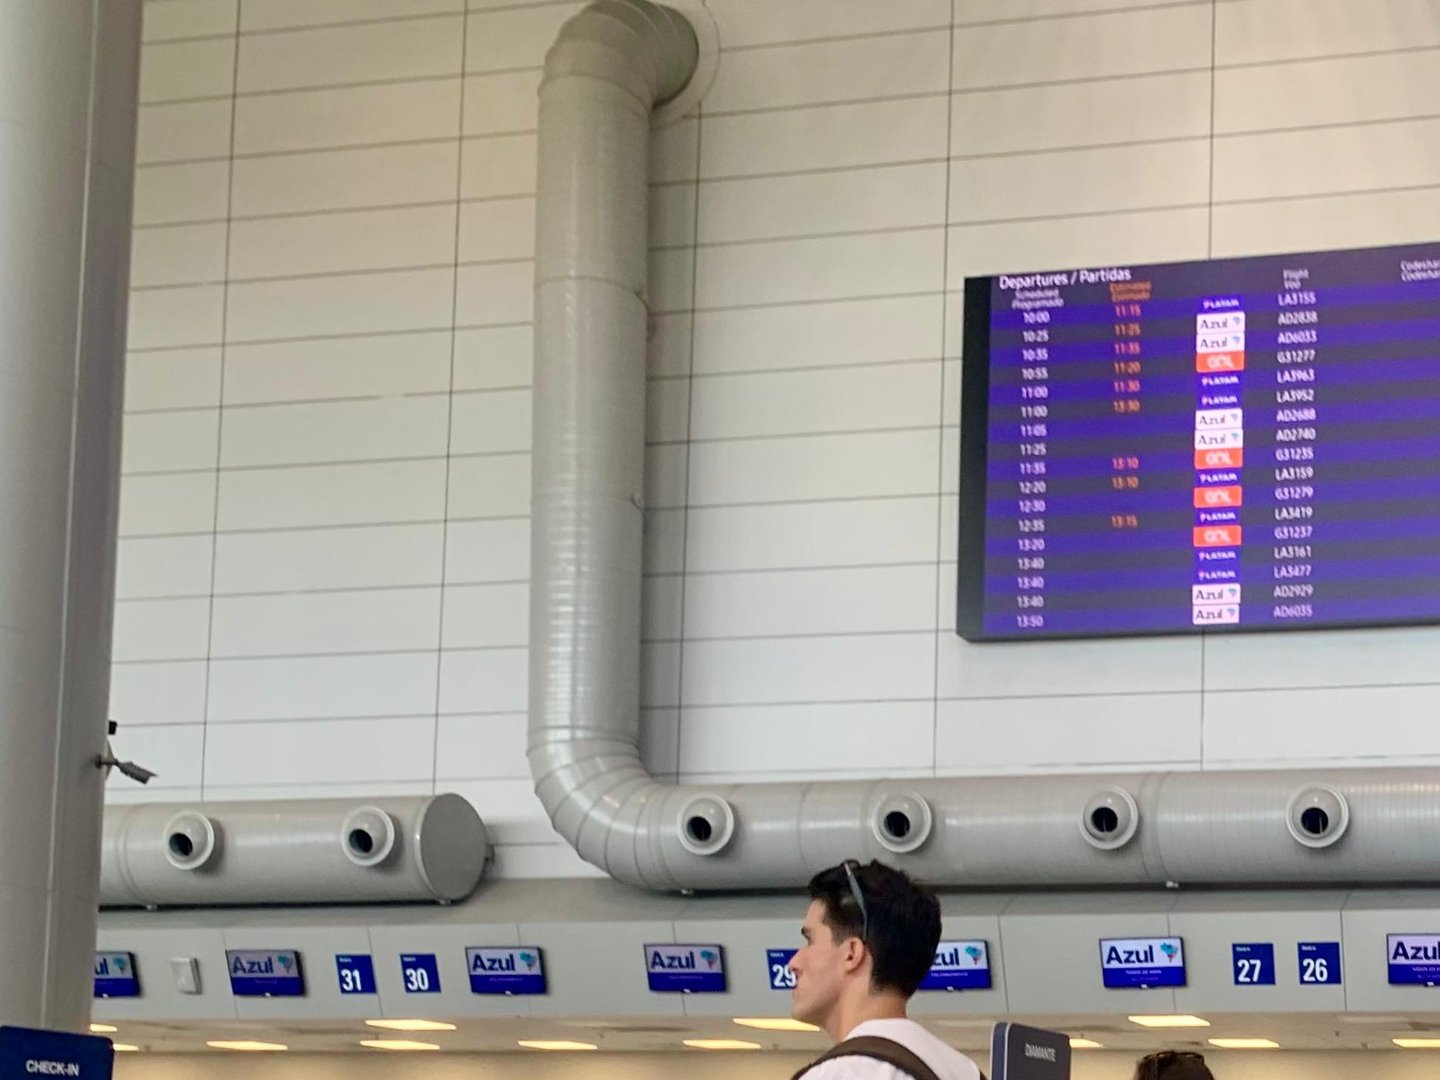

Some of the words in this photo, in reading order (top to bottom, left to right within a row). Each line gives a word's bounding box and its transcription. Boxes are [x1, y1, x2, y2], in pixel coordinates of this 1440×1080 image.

[1000, 270, 1067, 290] Departures
[1080, 268, 1132, 283] Partidas
[1200, 318, 1228, 330] Azul
[1022, 330, 1049, 343] 10:25
[1200, 337, 1228, 349] Azul
[1021, 387, 1048, 399] 11:00
[1021, 406, 1048, 418] 11:00
[1199, 414, 1226, 426] Azul
[1020, 425, 1048, 437] 11:05
[1198, 434, 1226, 446] Azul
[1020, 444, 1047, 456] 11:25
[1019, 462, 1047, 474] 11:35
[1019, 482, 1046, 494] 12:20
[1018, 520, 1046, 532] 12:35
[1018, 558, 1045, 570] 13:40
[1017, 577, 1044, 589] 13:40
[1196, 588, 1223, 600] Azul
[1196, 608, 1223, 620] Azul
[1016, 615, 1044, 627] 13:50
[650, 949, 696, 970] Azul
[931, 946, 960, 967] zul
[1106, 945, 1154, 965] Azul
[94, 958, 110, 976] ul
[232, 956, 274, 975] Azul
[472, 952, 516, 972] Azul
[772, 964, 797, 988] 29
[1238, 960, 1261, 983] 27
[1302, 959, 1328, 982] 26
[341, 970, 362, 991] 31
[406, 968, 430, 991] 30
[1024, 1043, 1056, 1062] DIAMANTE
[26, 1060, 80, 1076] CHECK-IN
